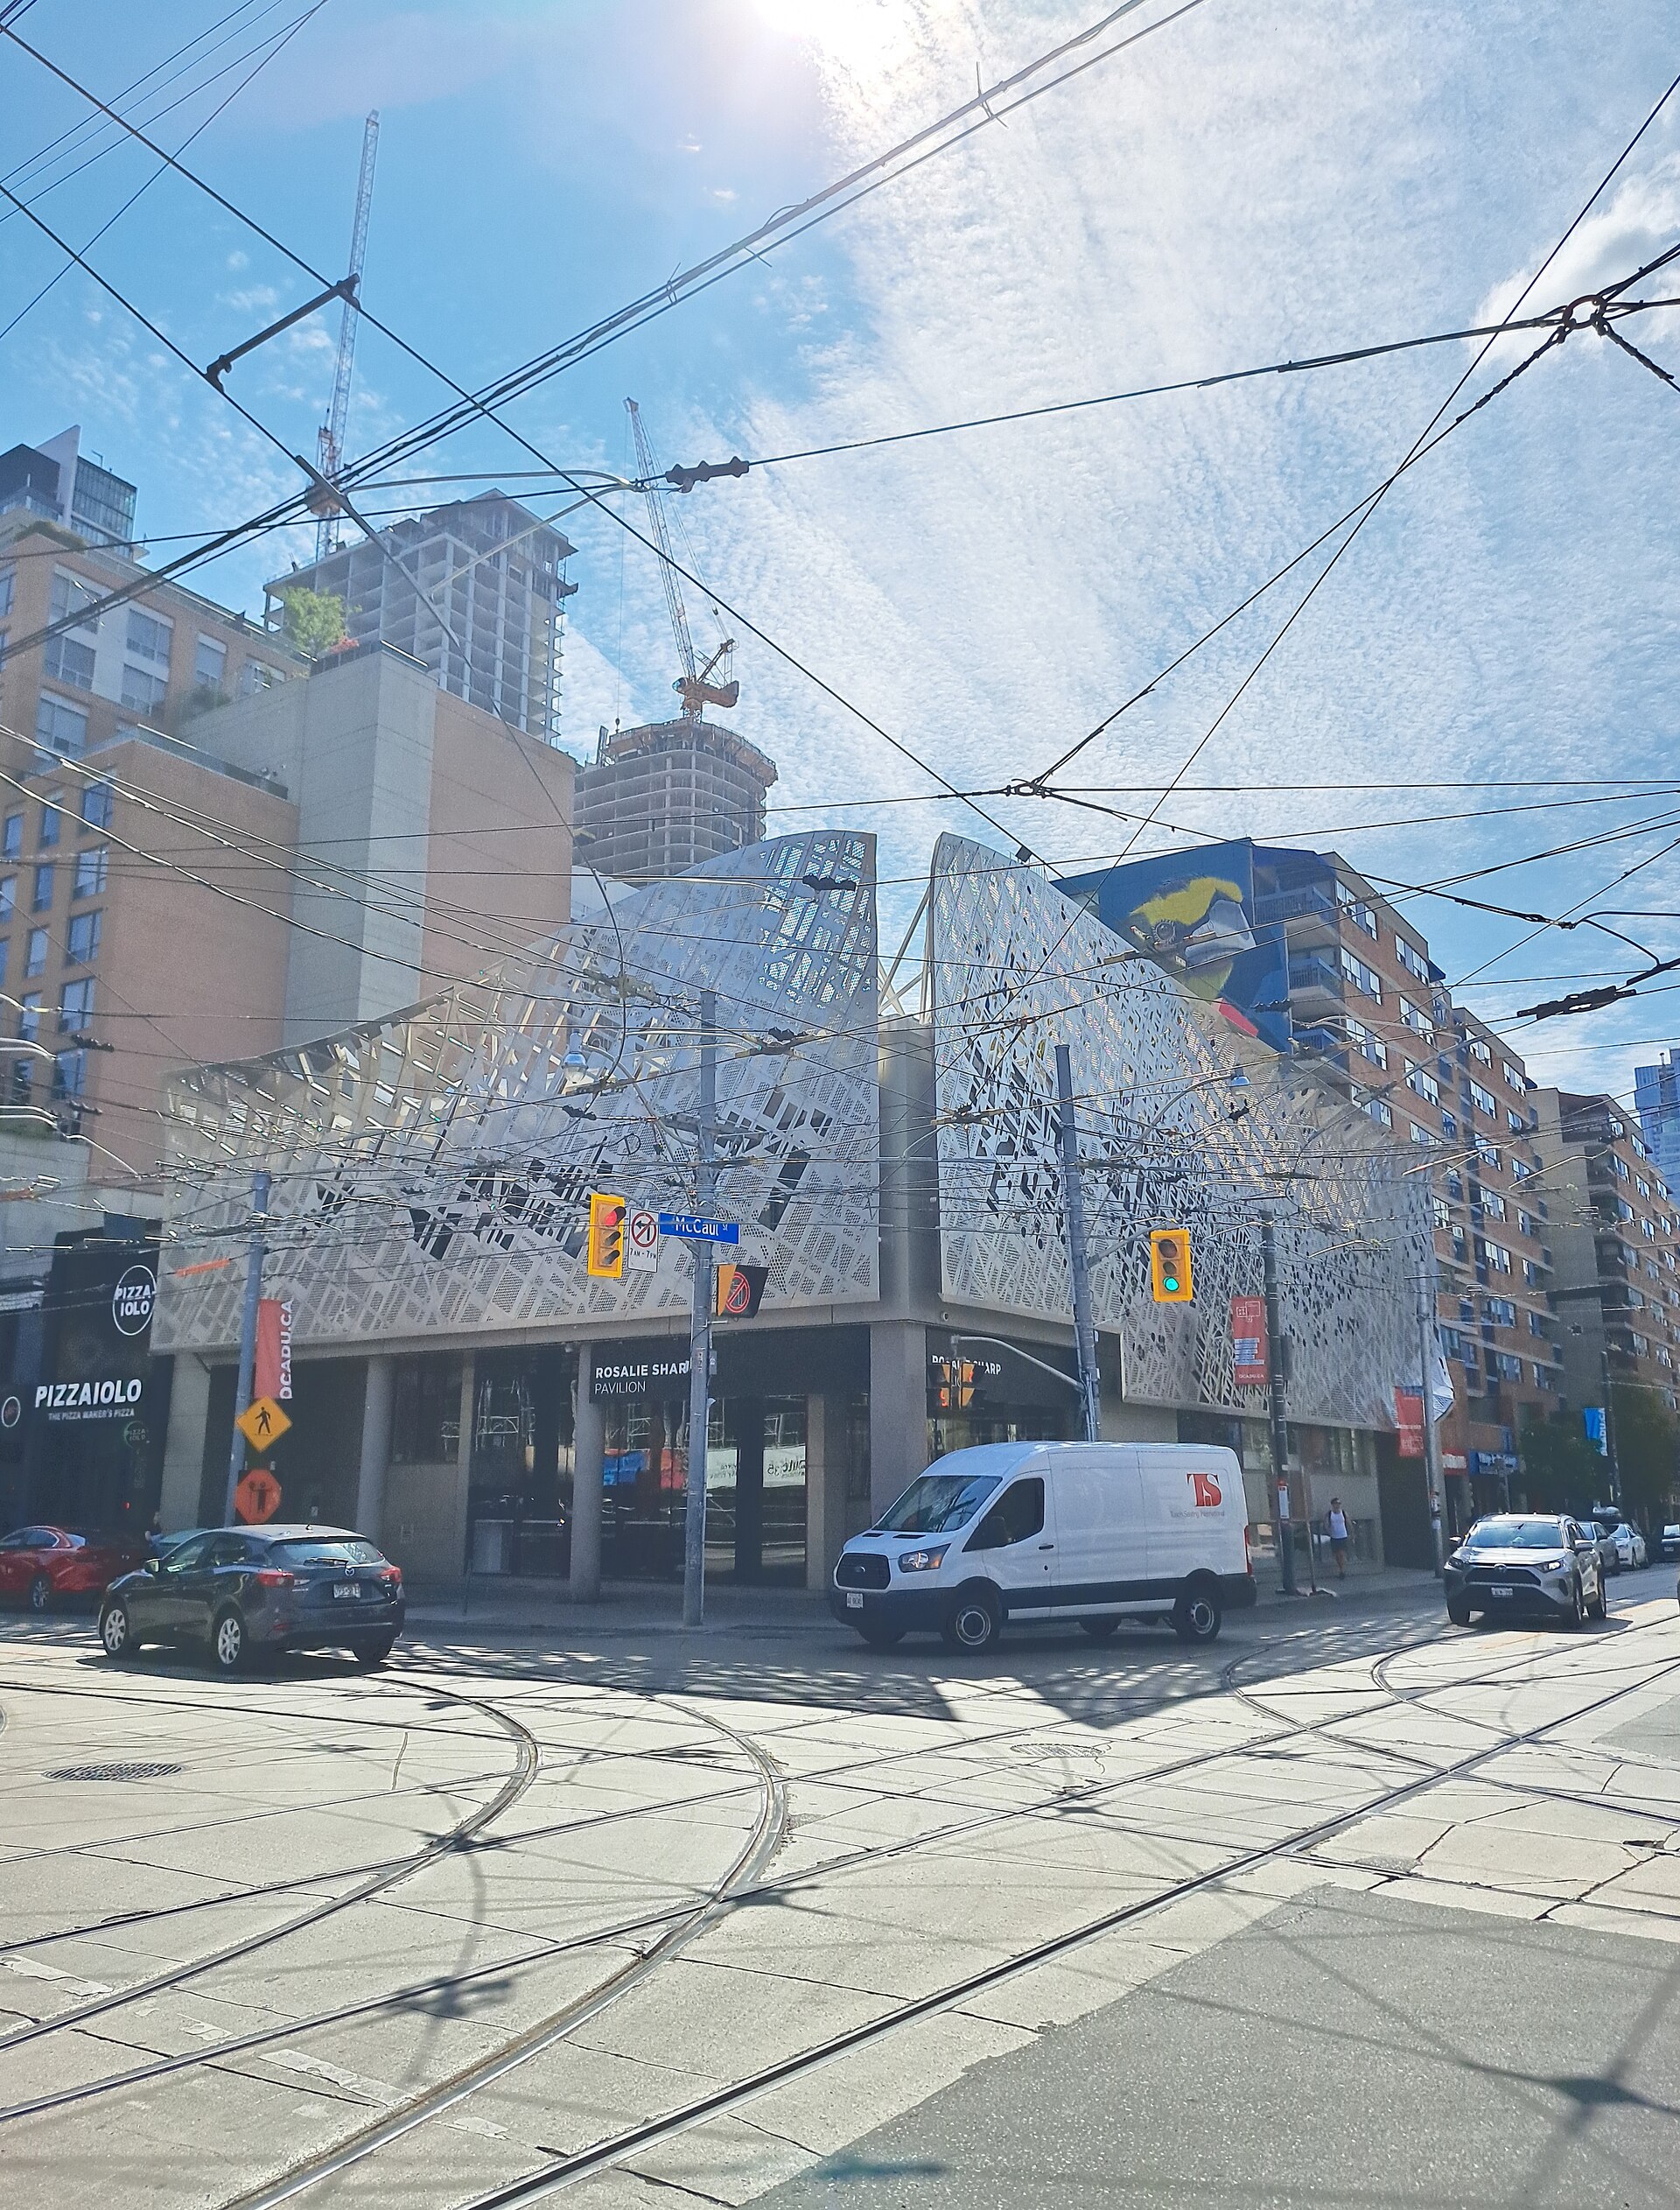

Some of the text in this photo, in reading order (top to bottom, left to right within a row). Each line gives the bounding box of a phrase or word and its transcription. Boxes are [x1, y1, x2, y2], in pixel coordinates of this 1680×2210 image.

[676, 1216, 718, 1236] McCaul
[114, 1285, 151, 1301] PIZZA
[120, 1301, 150, 1317] IOLO
[595, 1365, 648, 1379] ROSALIE
[973, 1361, 1001, 1375] ARP
[35, 1379, 143, 1408] PIZZAIOLO
[595, 1380, 646, 1395] PAVILION
[48, 1412, 60, 1421] THE
[62, 1411, 81, 1420] PIZZA
[114, 1407, 135, 1418] PIZZA
